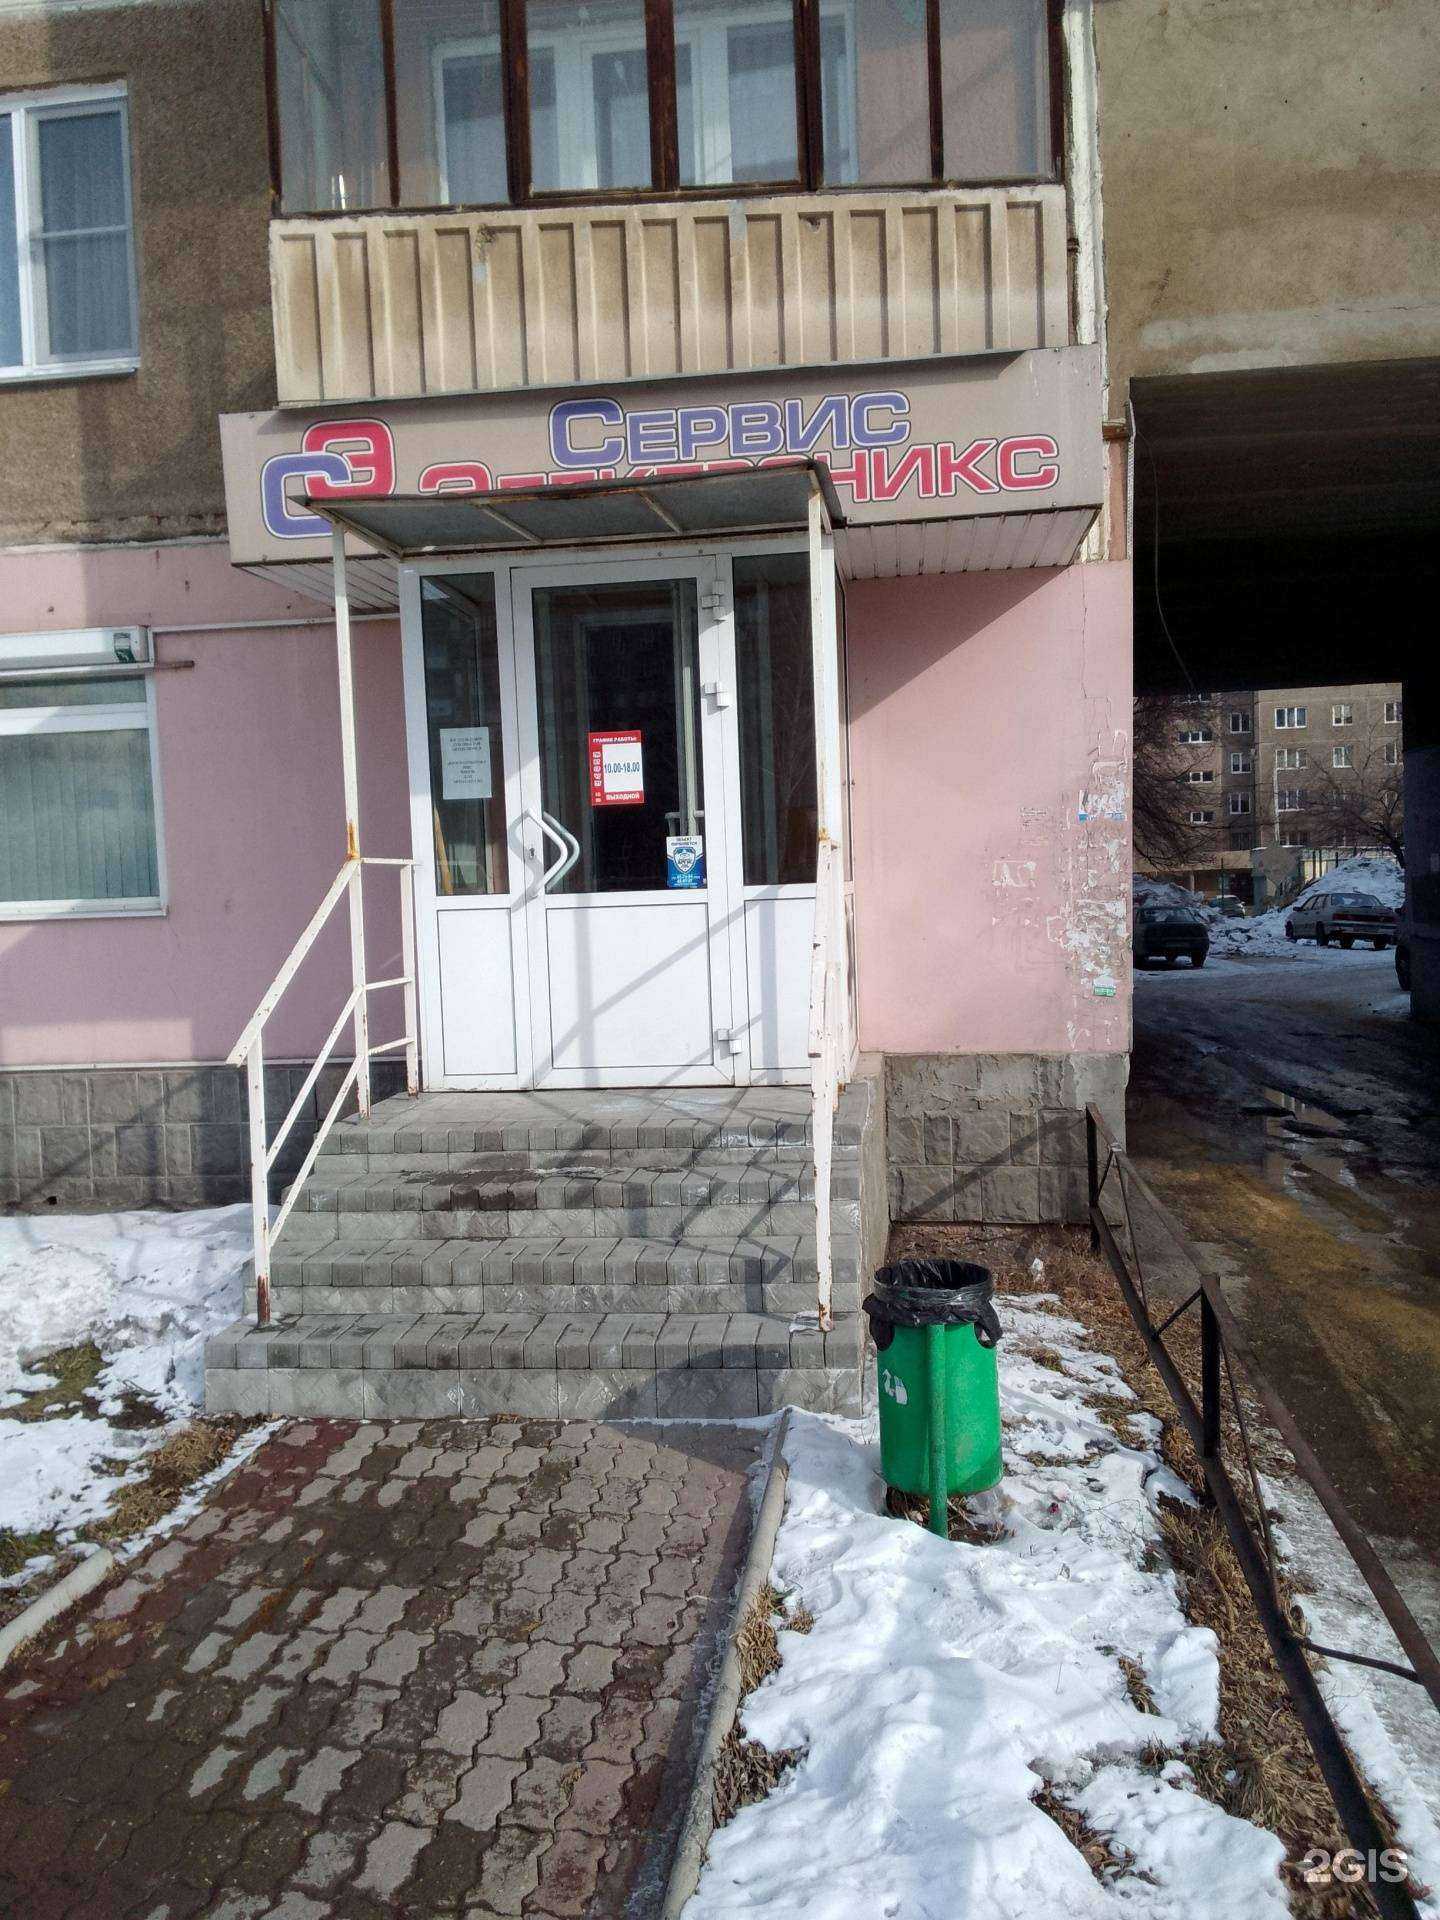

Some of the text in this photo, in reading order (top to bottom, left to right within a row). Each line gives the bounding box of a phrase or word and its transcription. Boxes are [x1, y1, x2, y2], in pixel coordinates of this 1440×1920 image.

[548, 391, 911, 469] СЕРВИС
[604, 762, 640, 774] 10.00-18.00
[605, 792, 640, 802] ВЫХОДНОЙ
